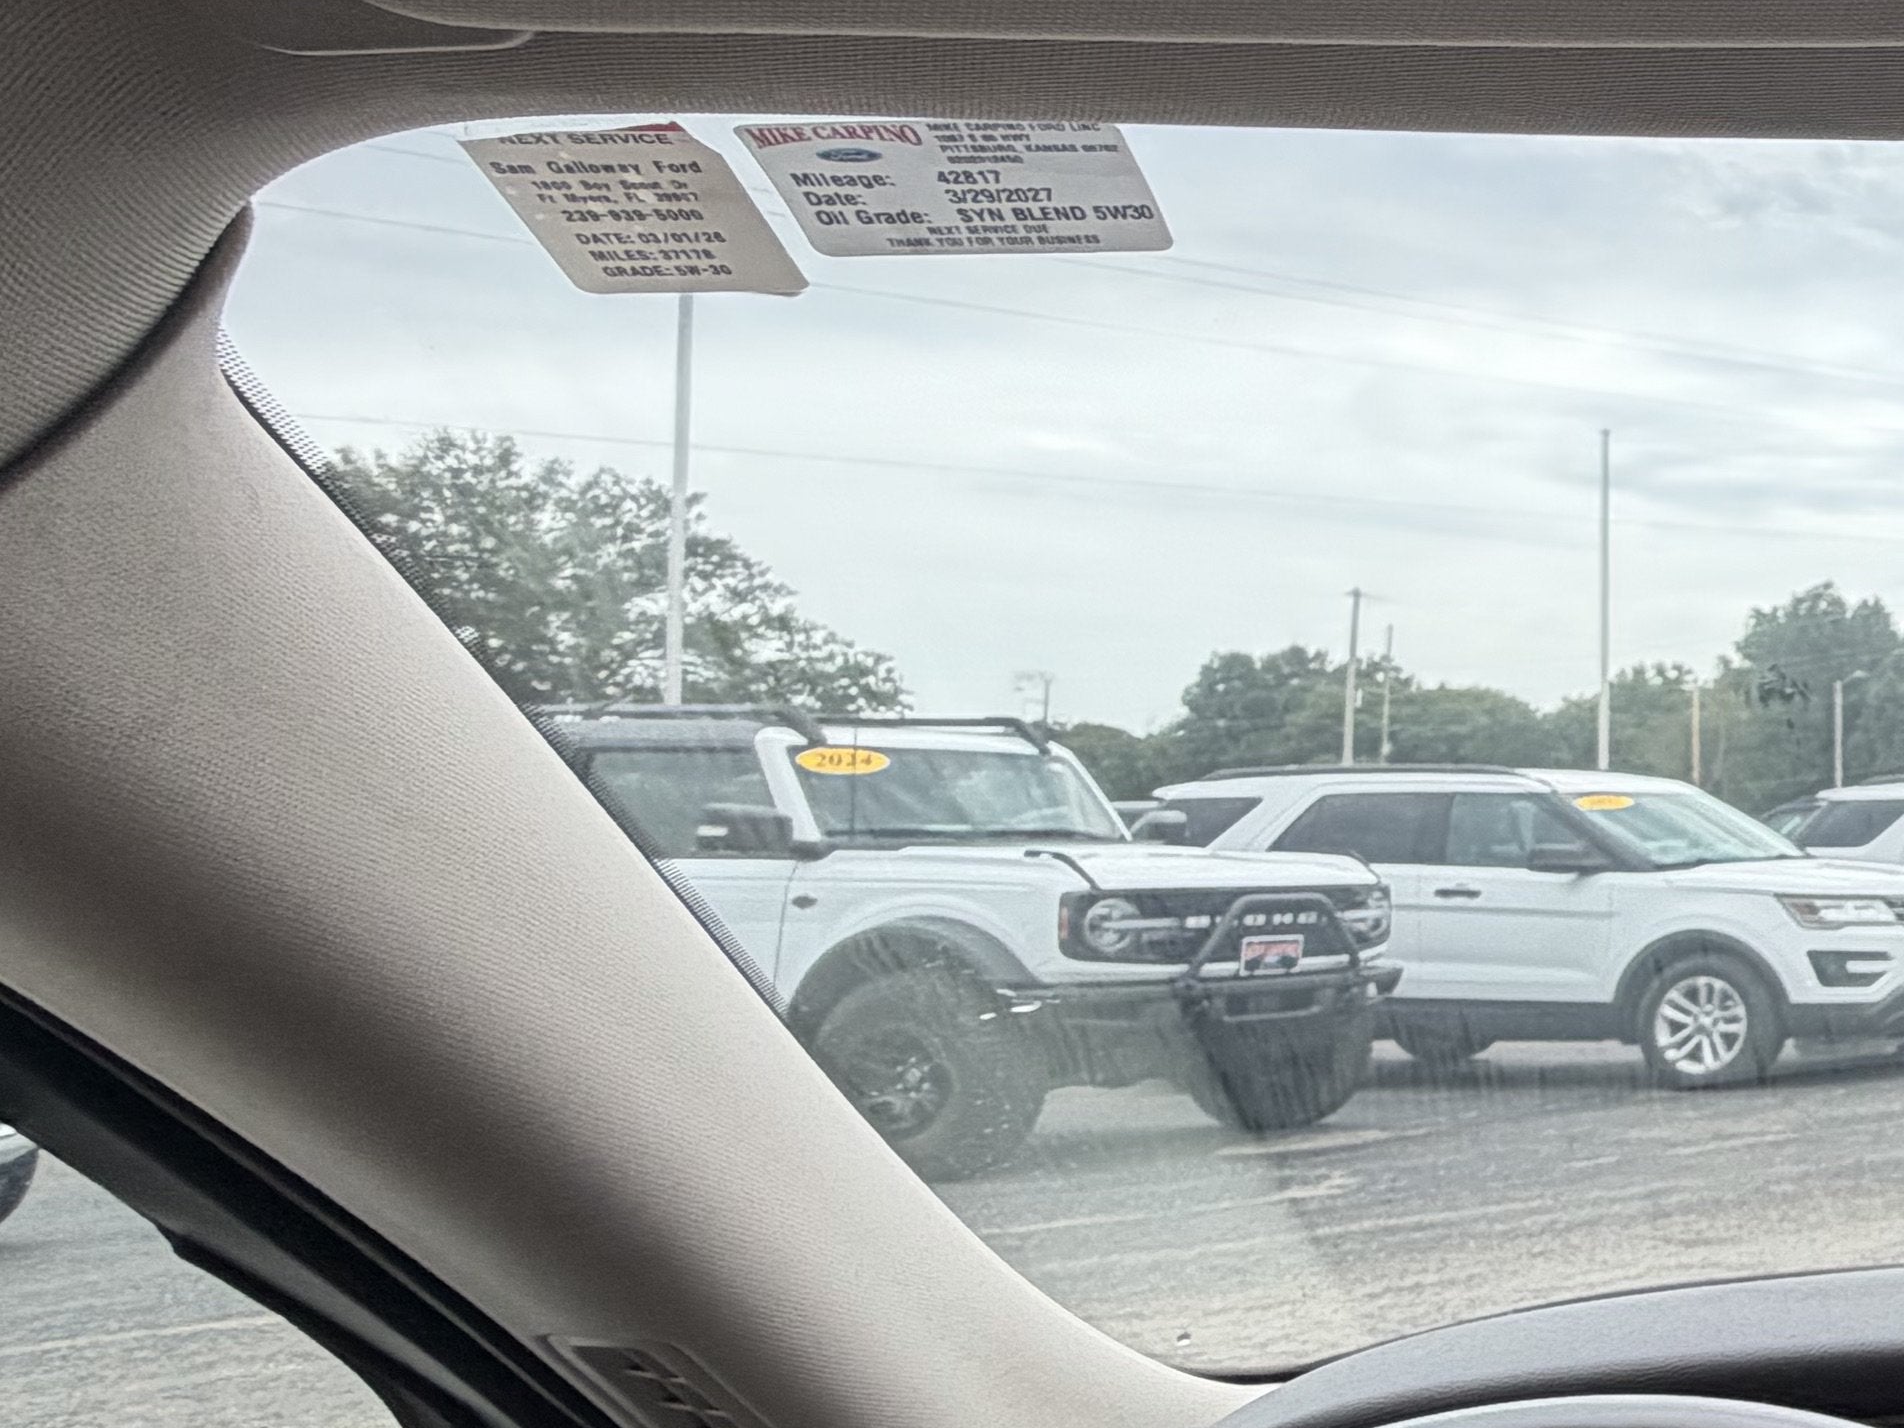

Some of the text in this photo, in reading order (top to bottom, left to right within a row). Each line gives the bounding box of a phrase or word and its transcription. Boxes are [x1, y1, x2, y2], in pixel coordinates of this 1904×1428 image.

[500, 132, 675, 146] NEXT SERVICE
[746, 124, 923, 149] MIKE CARPINO
[488, 160, 703, 177] Sam Galloway Ford
[789, 171, 1003, 189] Mileage: 42817
[802, 188, 1053, 207] Date: 3/29/2027
[814, 204, 1154, 226] Oil Grade: SYN BLEND 5W30
[927, 225, 1050, 236] NEXT SERVICE DUE
[574, 232, 635, 246] DATE:
[886, 235, 1101, 248] THANK YOU FOR YOUR BUSINESS
[588, 250, 660, 263] MILES:
[601, 265, 675, 278] GRADE:
